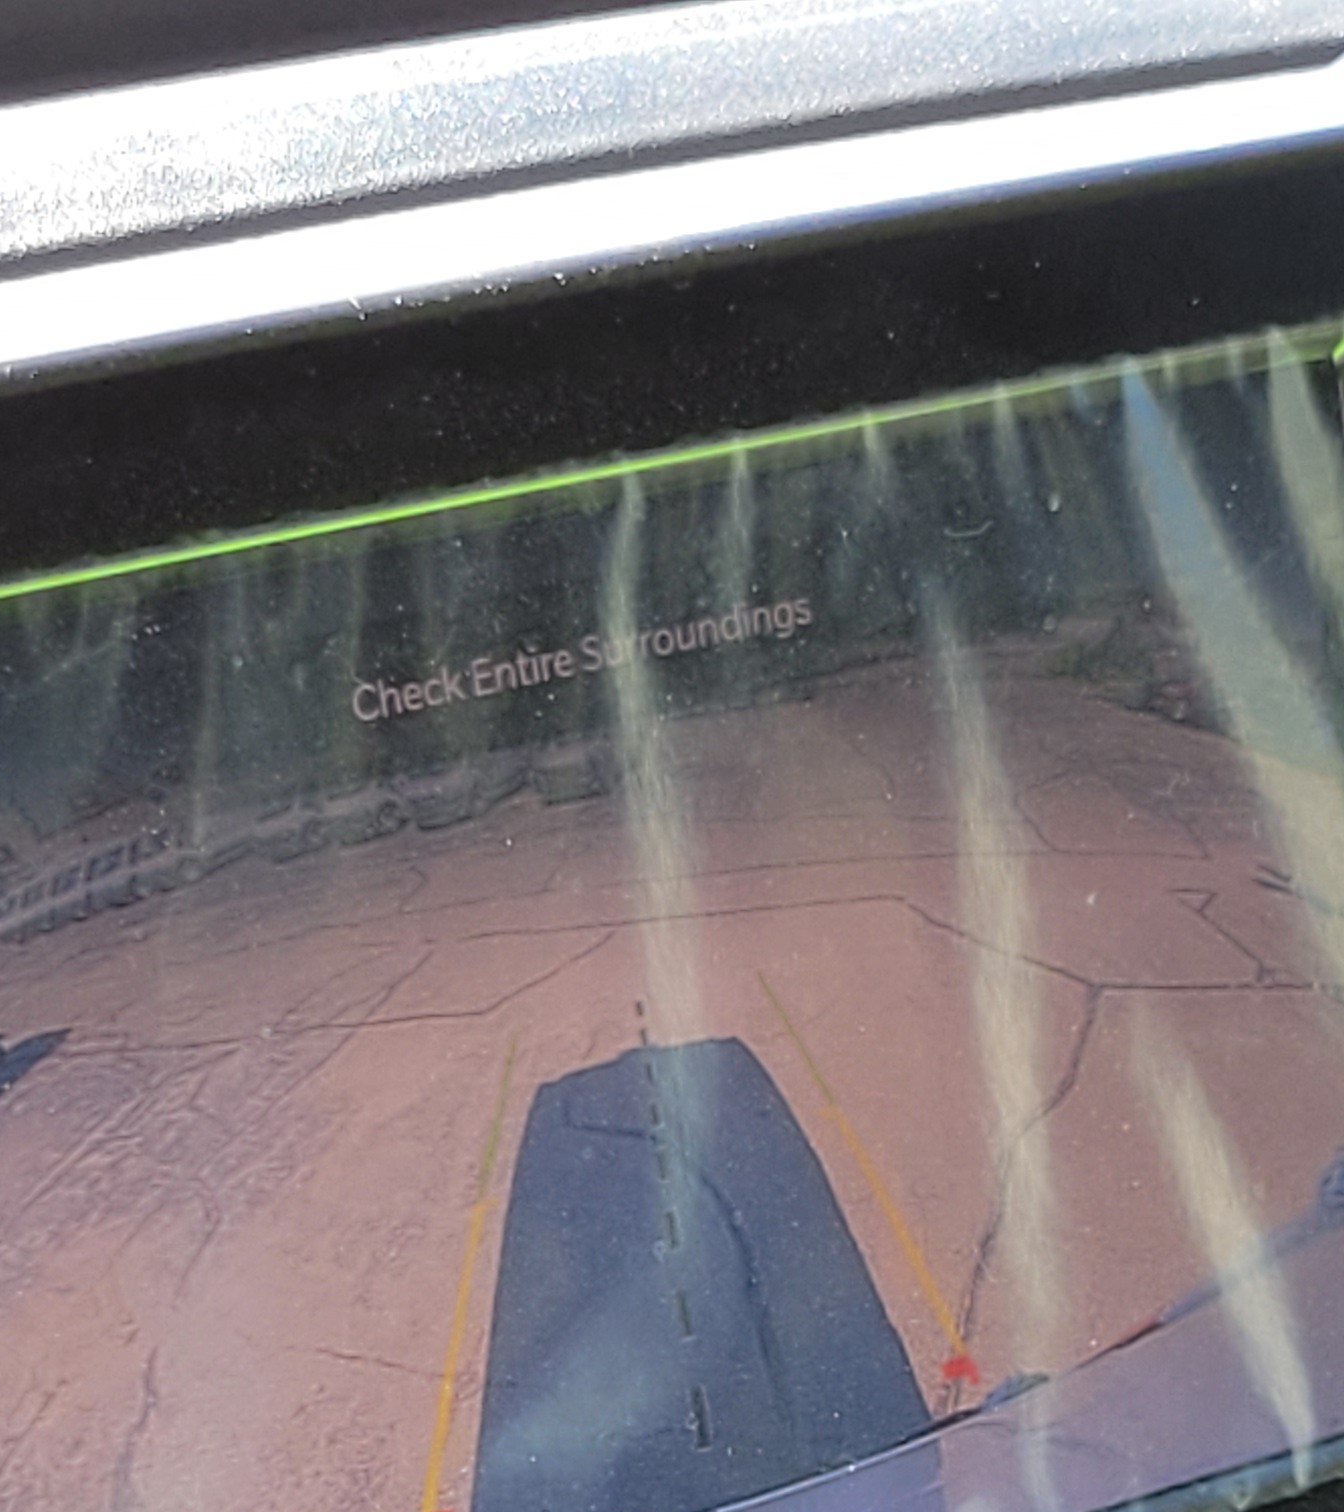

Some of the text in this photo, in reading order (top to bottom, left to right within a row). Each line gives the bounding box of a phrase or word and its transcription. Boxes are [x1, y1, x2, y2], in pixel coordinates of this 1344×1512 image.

[353, 598, 812, 723] Check Entire Surroundings
